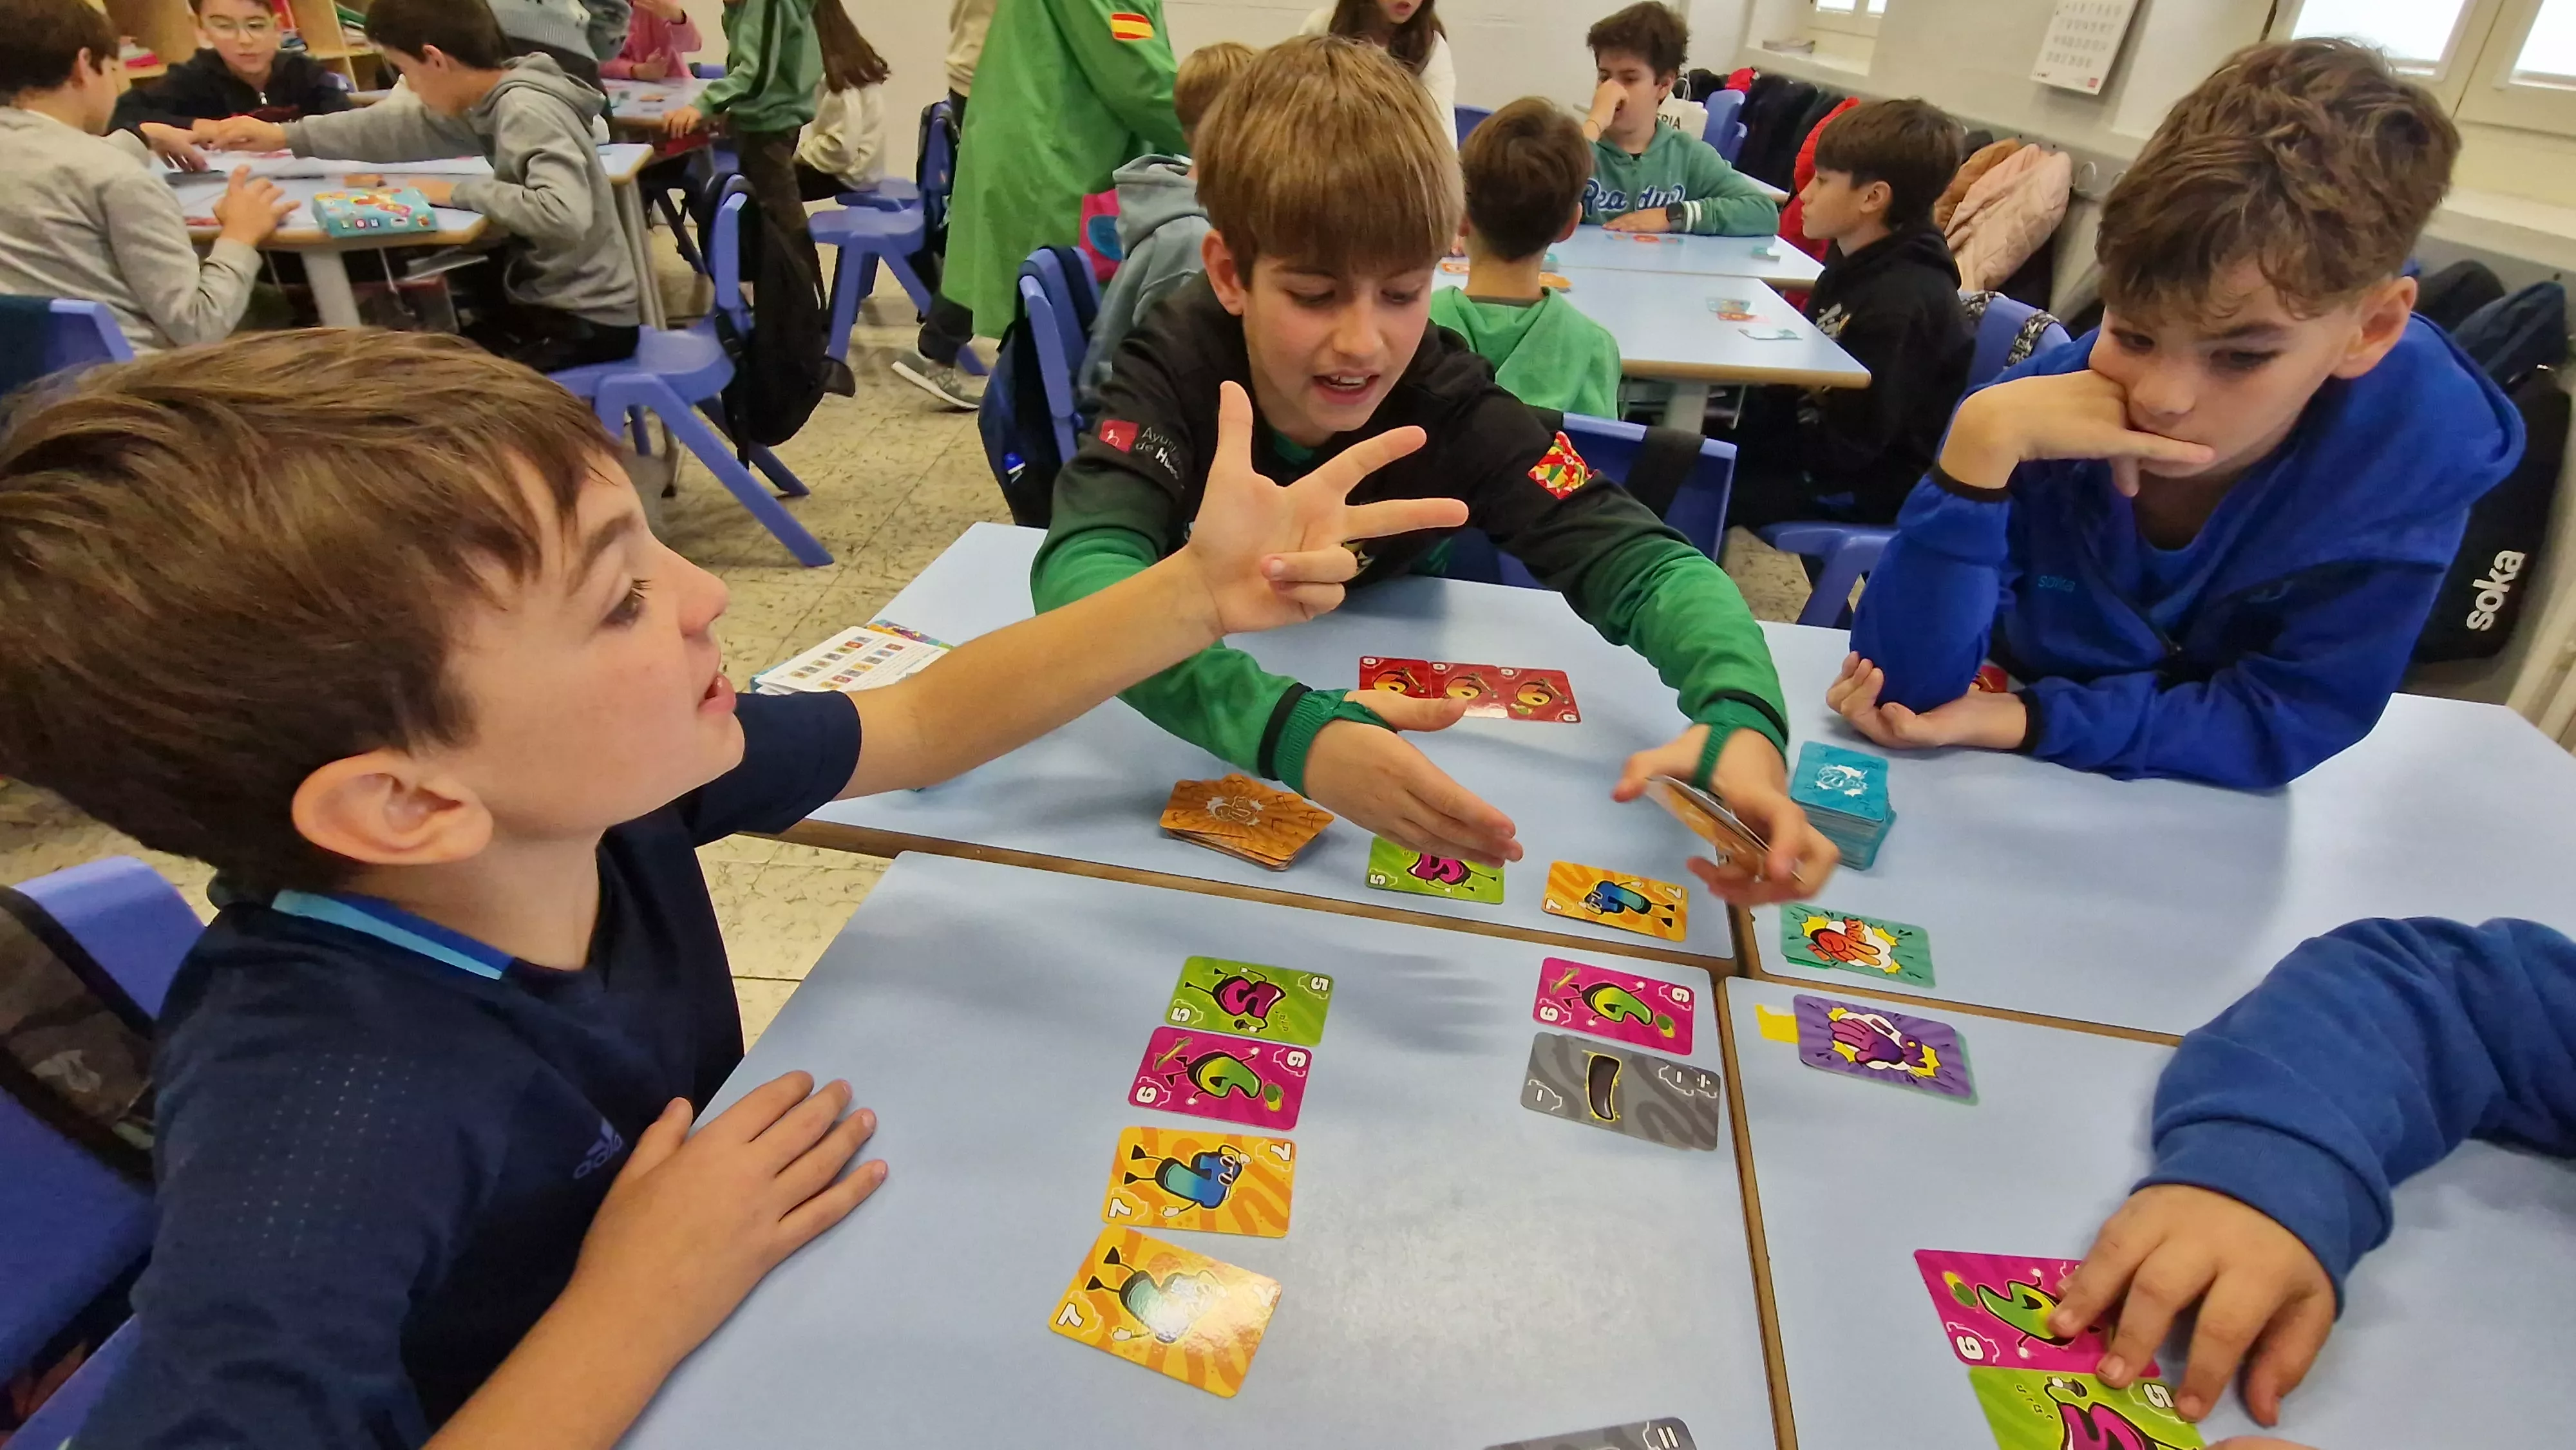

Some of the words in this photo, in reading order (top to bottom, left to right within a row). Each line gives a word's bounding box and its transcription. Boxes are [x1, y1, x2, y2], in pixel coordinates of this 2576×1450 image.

[2467, 550, 2527, 632] soka
[1369, 874, 1386, 885] 5
[1665, 886, 1682, 899] 7
[1545, 898, 1562, 910] 7
[1310, 976, 1330, 992] 5
[1170, 1007, 1191, 1022] 5
[1287, 1050, 1307, 1068] 6
[1135, 1086, 1158, 1104] 6
[1270, 1142, 1293, 1162] 7
[1108, 1197, 1132, 1218] 7
[1056, 1302, 1084, 1328] 7
[2143, 1382, 2176, 1409] 5
